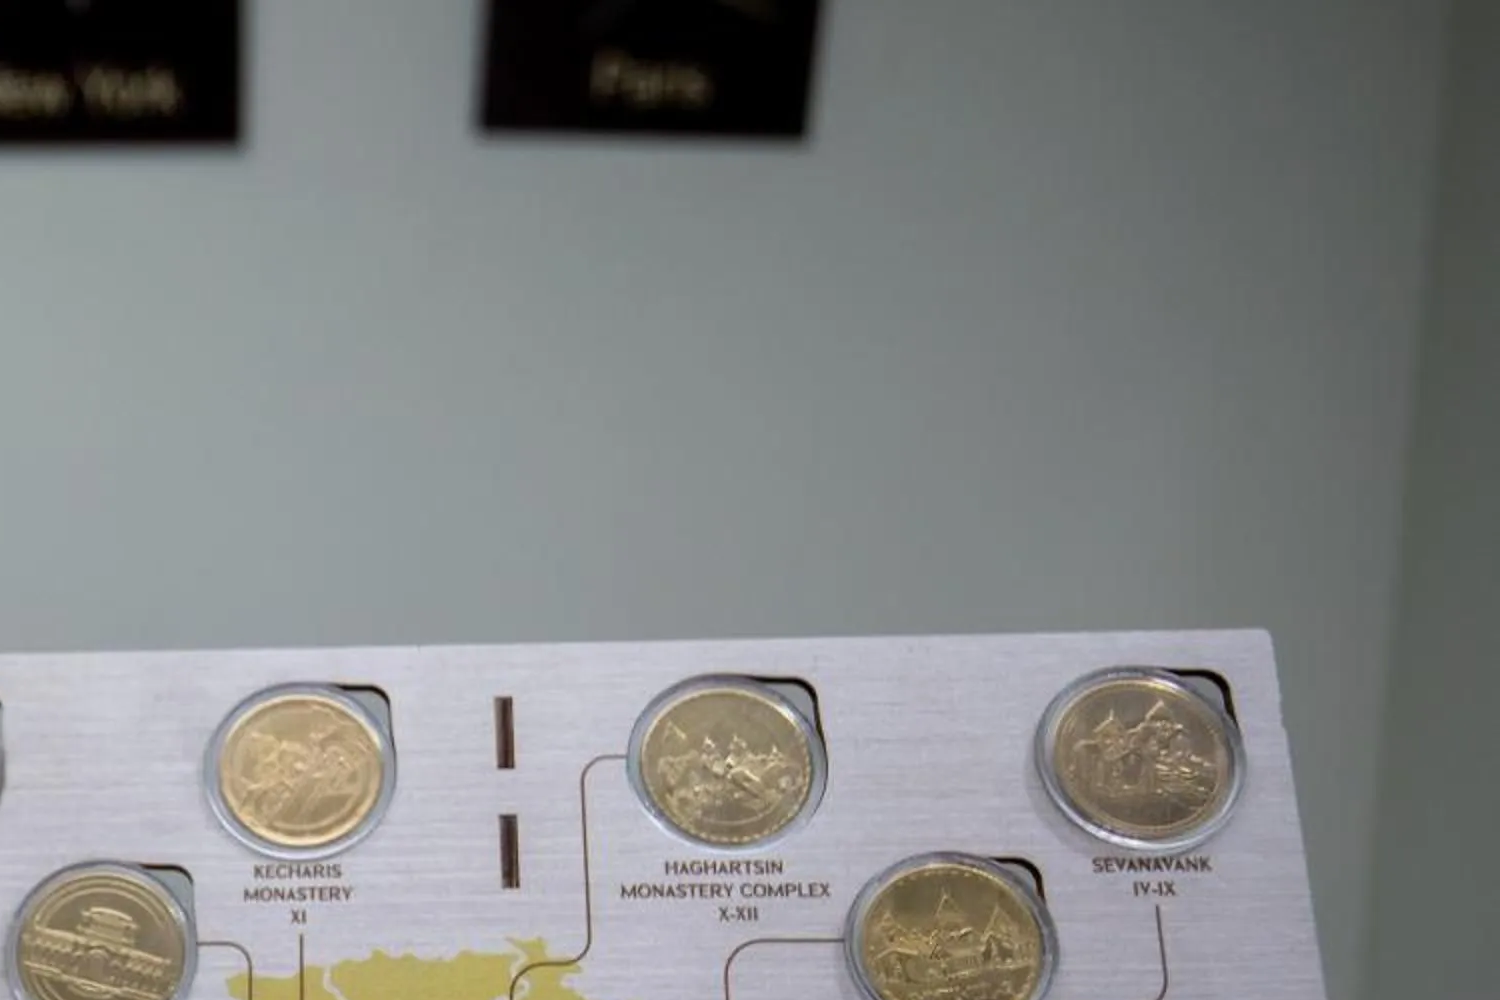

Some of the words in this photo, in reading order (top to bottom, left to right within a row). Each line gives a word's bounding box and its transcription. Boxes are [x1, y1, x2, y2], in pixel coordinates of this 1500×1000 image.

[590, 48, 712, 105] Paris
[80, 58, 182, 116] York
[253, 863, 342, 880] KECHARIS
[664, 858, 783, 876] HAGHARTSIN
[1092, 854, 1213, 874] SEVANAVANK
[243, 886, 353, 903] MONASTERY
[620, 882, 732, 900] MONASTERY
[739, 882, 830, 900] COMPLEX
[1133, 880, 1176, 898] IV-IX
[291, 909, 306, 926] XI
[718, 905, 759, 922] X-XII
